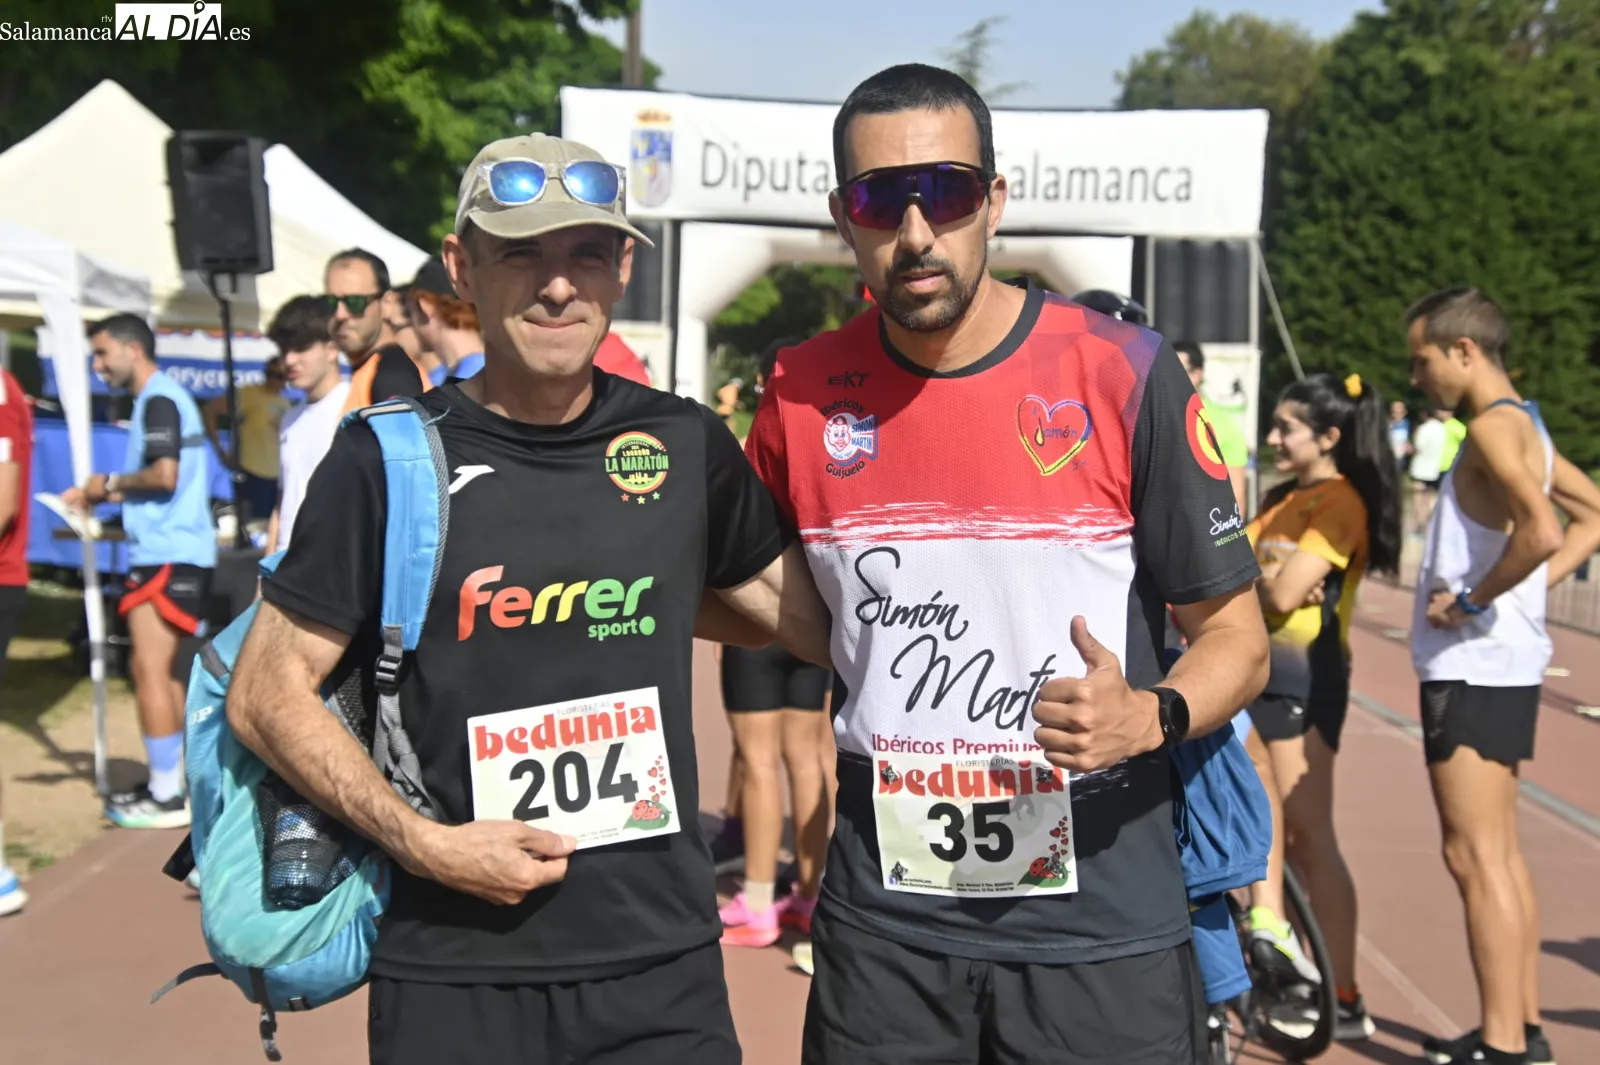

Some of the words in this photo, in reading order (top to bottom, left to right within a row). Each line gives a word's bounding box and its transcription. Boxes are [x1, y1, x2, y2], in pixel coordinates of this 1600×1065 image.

[701, 139, 831, 203] Diputa
[996, 150, 1193, 202] alamanca
[828, 371, 871, 388] EKT
[604, 457, 619, 472] LA
[620, 453, 669, 472] MARATÓN
[825, 460, 866, 479] Guijuelo
[854, 546, 969, 642] Simón
[588, 619, 638, 641] sport
[474, 701, 657, 762] bedunia
[872, 733, 945, 755] Ibéricos
[509, 742, 639, 822] 204
[877, 760, 1065, 799] bedunia
[927, 801, 1014, 863] 35
